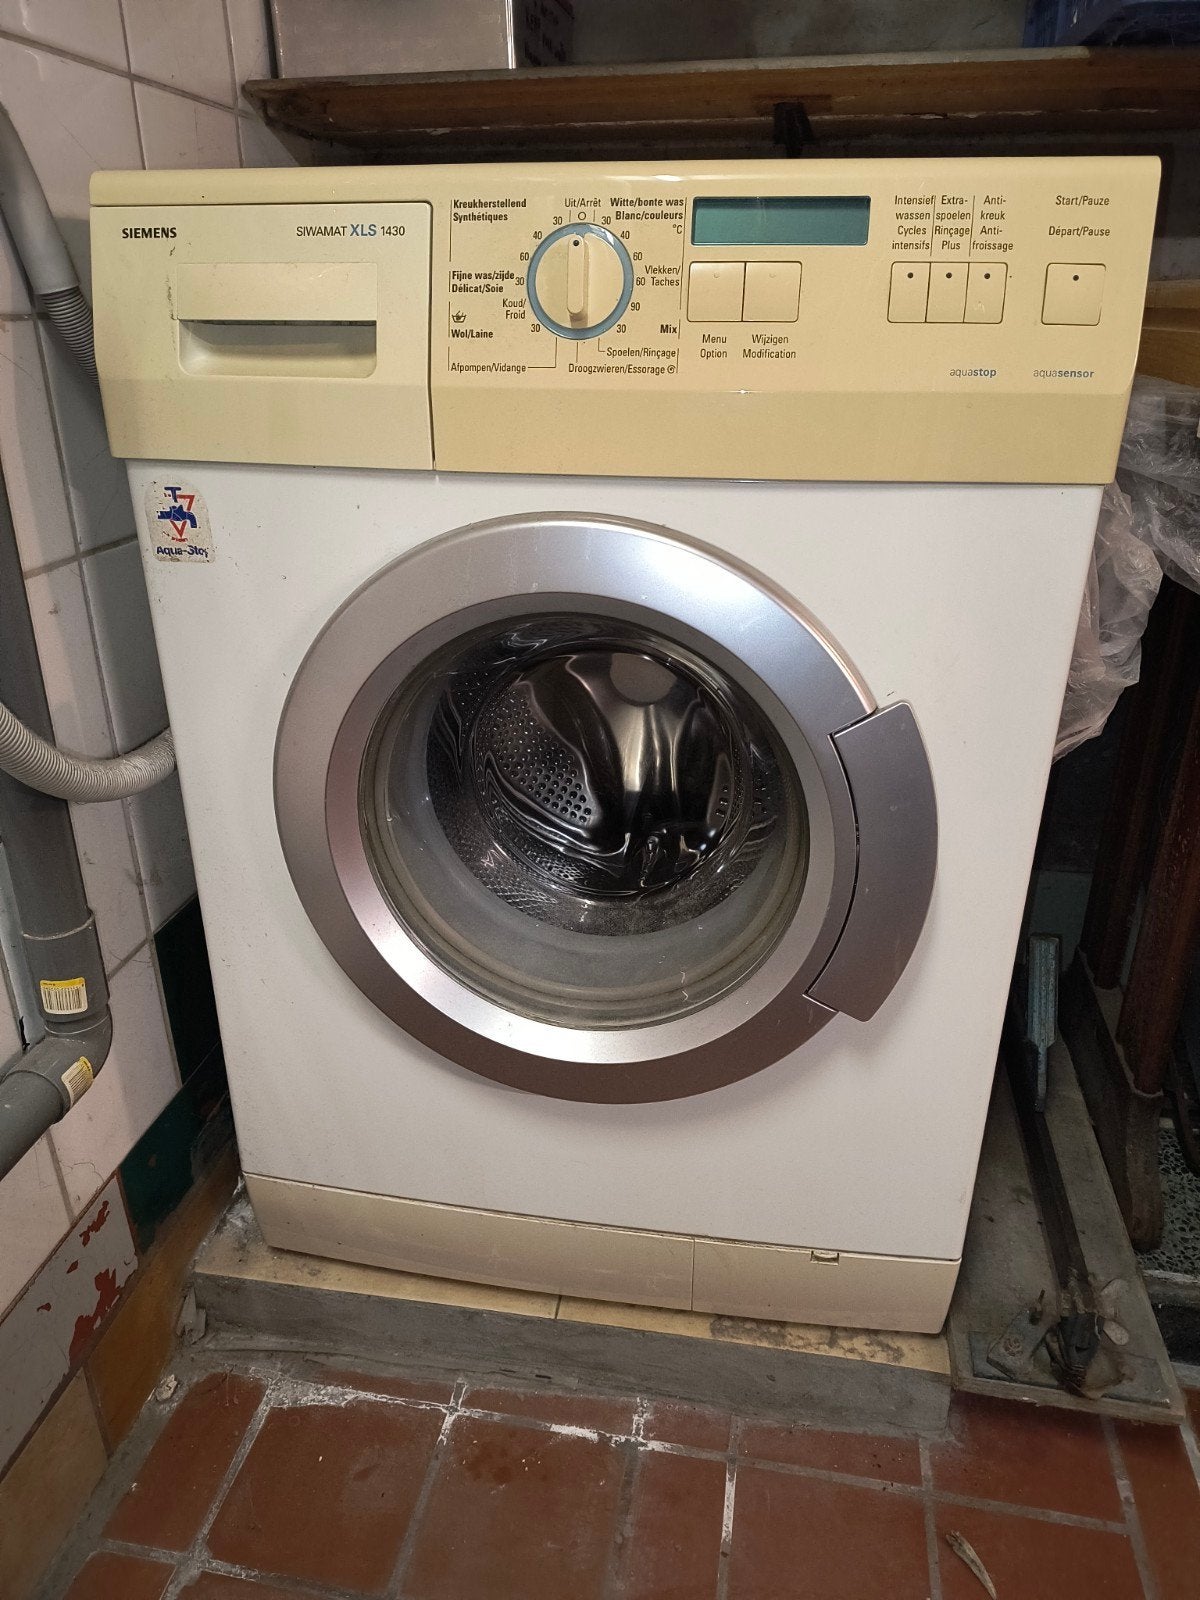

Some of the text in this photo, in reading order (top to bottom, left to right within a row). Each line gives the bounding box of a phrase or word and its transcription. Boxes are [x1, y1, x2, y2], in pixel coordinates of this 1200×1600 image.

[453, 198, 527, 209] Kreukherstellend
[564, 197, 602, 208] Uit/Arrêt
[610, 197, 684, 208] Witte/bonte was
[894, 195, 936, 205] Intensief
[941, 195, 968, 205] Extra-
[983, 195, 1007, 205] Anti-
[1055, 195, 1110, 206] Start/Pauze
[453, 212, 508, 223] Synthétiques
[615, 211, 684, 220] Blanc/couleurs
[895, 212, 931, 220] wassen
[935, 211, 971, 222] spoelen
[980, 210, 1006, 220] kreuk
[553, 216, 563, 225] 30
[601, 216, 611, 225] 30
[121, 227, 177, 239] SIEMENS
[296, 224, 406, 236] SIWAMAT XLS 1430
[533, 231, 542, 239] 40
[620, 230, 630, 239] 40
[897, 225, 927, 237] Cycles
[934, 225, 970, 238] Rinçage
[979, 225, 1003, 235] Anti-
[1048, 225, 1111, 237] Départ/Pause
[891, 240, 930, 250] intensifs
[941, 240, 961, 250] Plus
[972, 240, 1014, 252] froissage
[519, 252, 529, 261] 60
[633, 252, 642, 261] 60
[644, 265, 681, 275] Vlekken/
[452, 271, 515, 281] Fijne was/zijde
[635, 276, 645, 286] 60
[650, 276, 680, 286] Taches
[515, 277, 525, 286] 30
[451, 283, 504, 294] Délicat/Soie
[502, 298, 527, 308] Koud/
[630, 302, 640, 311] 90
[505, 310, 526, 319] Froid
[530, 324, 540, 333] 30
[616, 324, 627, 333] 30
[660, 324, 678, 334] Mix
[451, 329, 493, 339] Wol/Laine
[702, 334, 727, 343] Menu
[751, 334, 789, 345] Wijzigen
[606, 347, 676, 359] Spoelen/Rinçage
[700, 348, 728, 360] Option
[742, 348, 796, 359] Modification
[450, 362, 527, 374] Afpompen/Vidange
[568, 363, 666, 376] Droogzwieren/Essorage
[949, 368, 997, 378] aquastop
[1033, 368, 1095, 378] aquasensor
